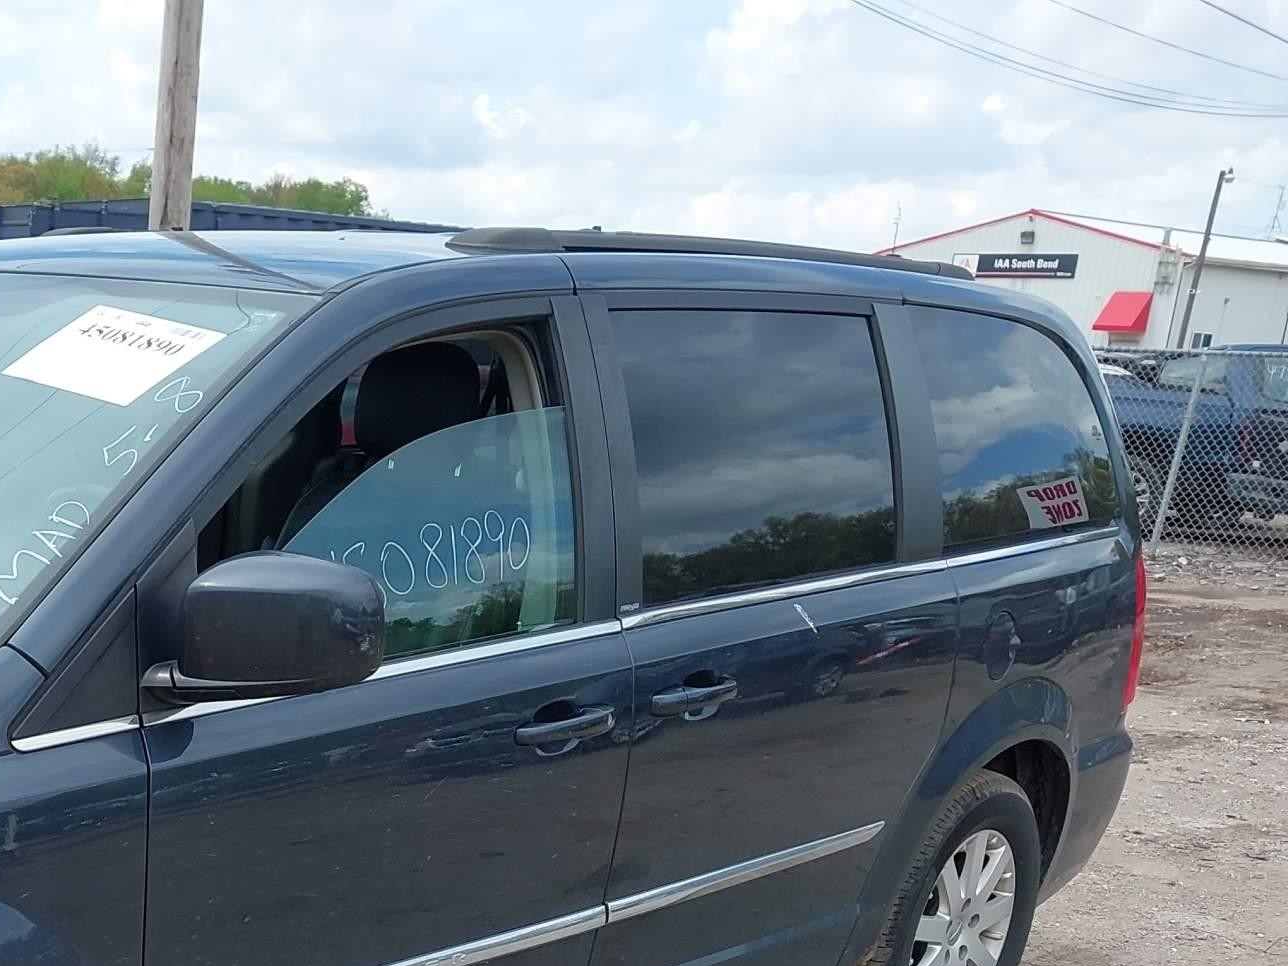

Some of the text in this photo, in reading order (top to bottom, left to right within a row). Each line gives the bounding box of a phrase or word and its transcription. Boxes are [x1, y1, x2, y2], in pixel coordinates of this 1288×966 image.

[994, 258, 1060, 269] IAA South Bend
